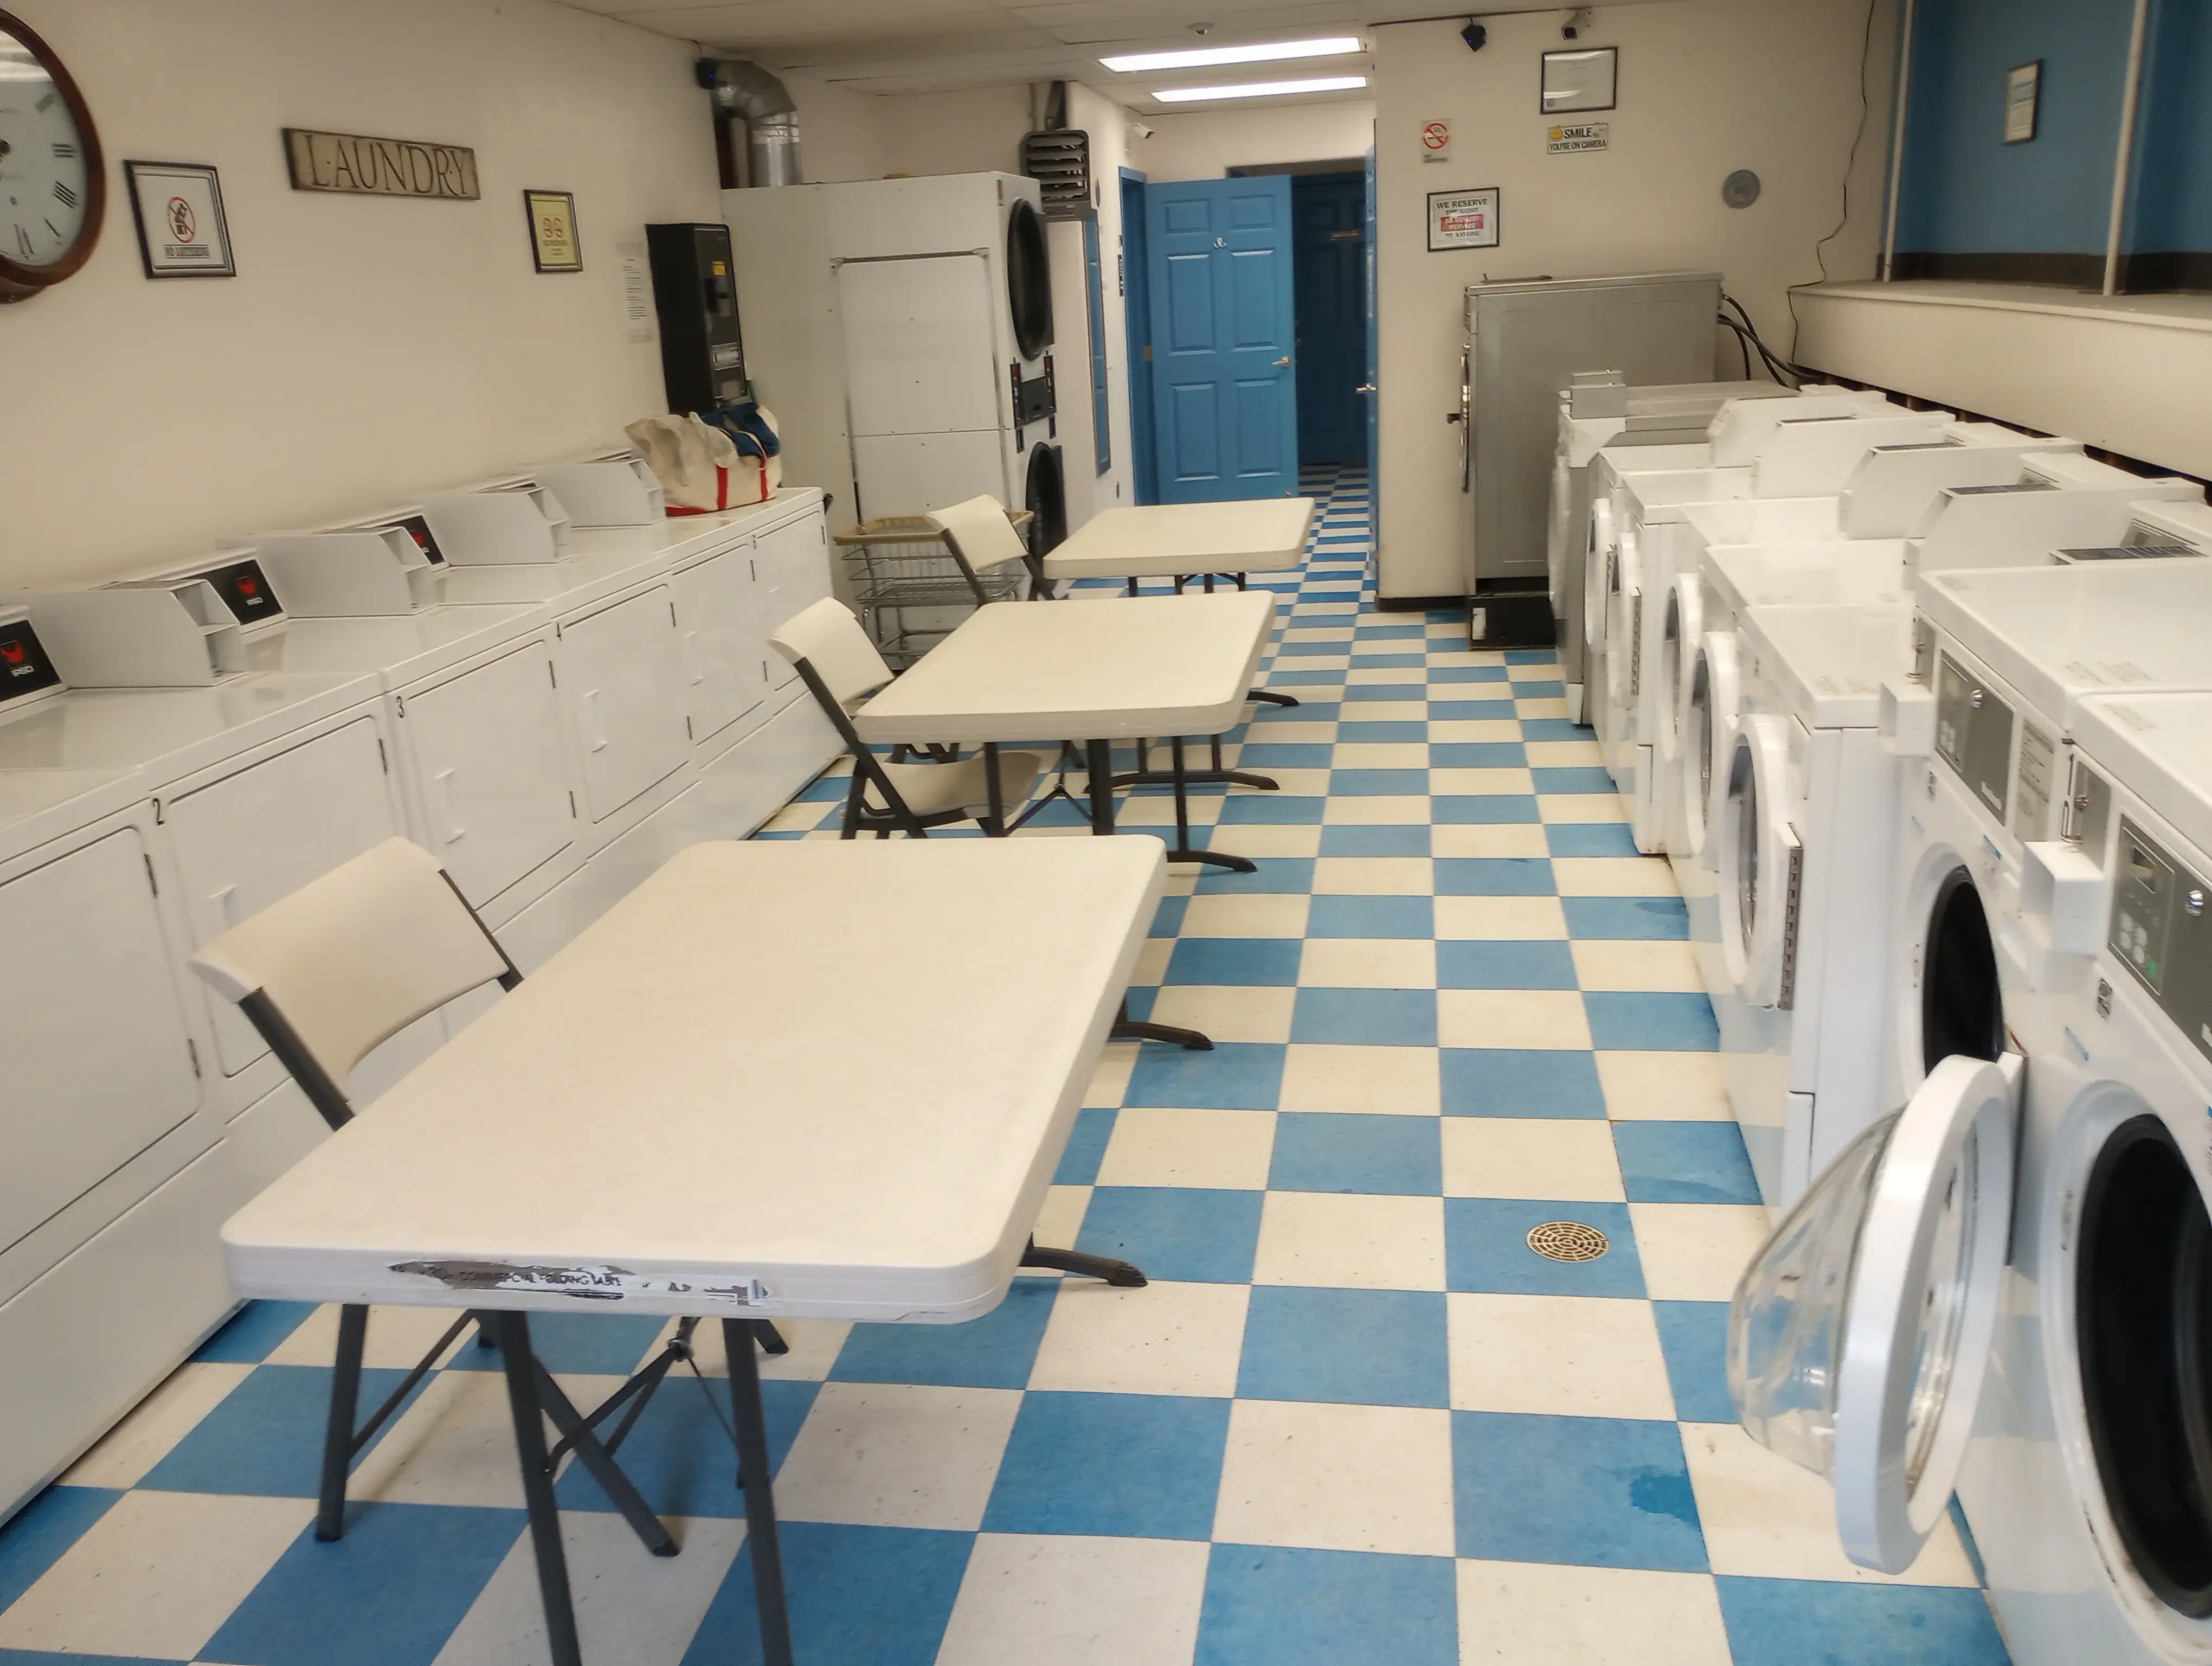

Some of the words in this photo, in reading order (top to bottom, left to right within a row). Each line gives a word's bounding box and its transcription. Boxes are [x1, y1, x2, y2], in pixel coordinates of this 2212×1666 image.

[1572, 142, 1581, 150] ON
[301, 134, 472, 196] LAUNDRY
[1452, 198, 1488, 208] RESERVE
[396, 695, 404, 719] 3
[152, 797, 165, 826] 2
